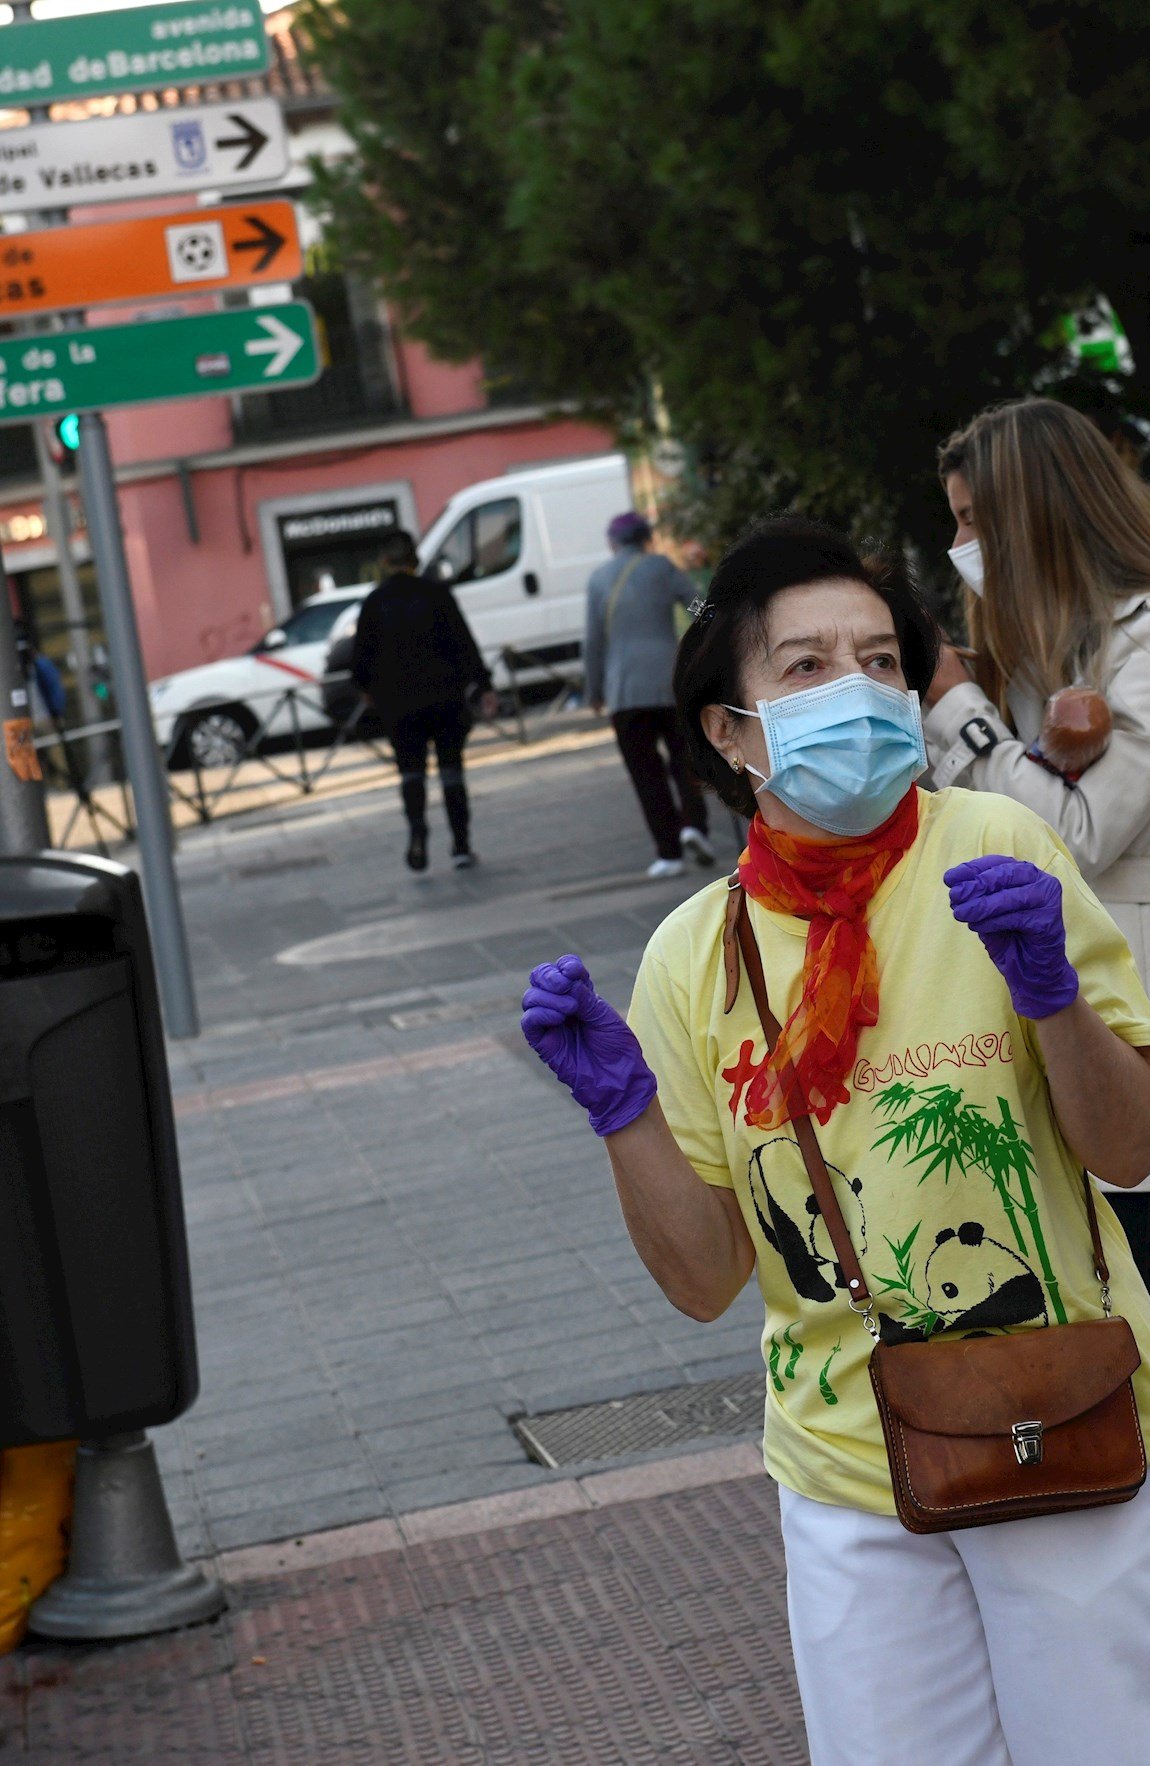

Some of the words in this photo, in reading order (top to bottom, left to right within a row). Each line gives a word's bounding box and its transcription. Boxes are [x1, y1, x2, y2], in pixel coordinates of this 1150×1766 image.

[151, 6, 255, 41] avenida
[39, 159, 157, 190] Vallecas
[0, 277, 46, 302] as
[21, 347, 57, 371] de
[68, 339, 96, 365] la
